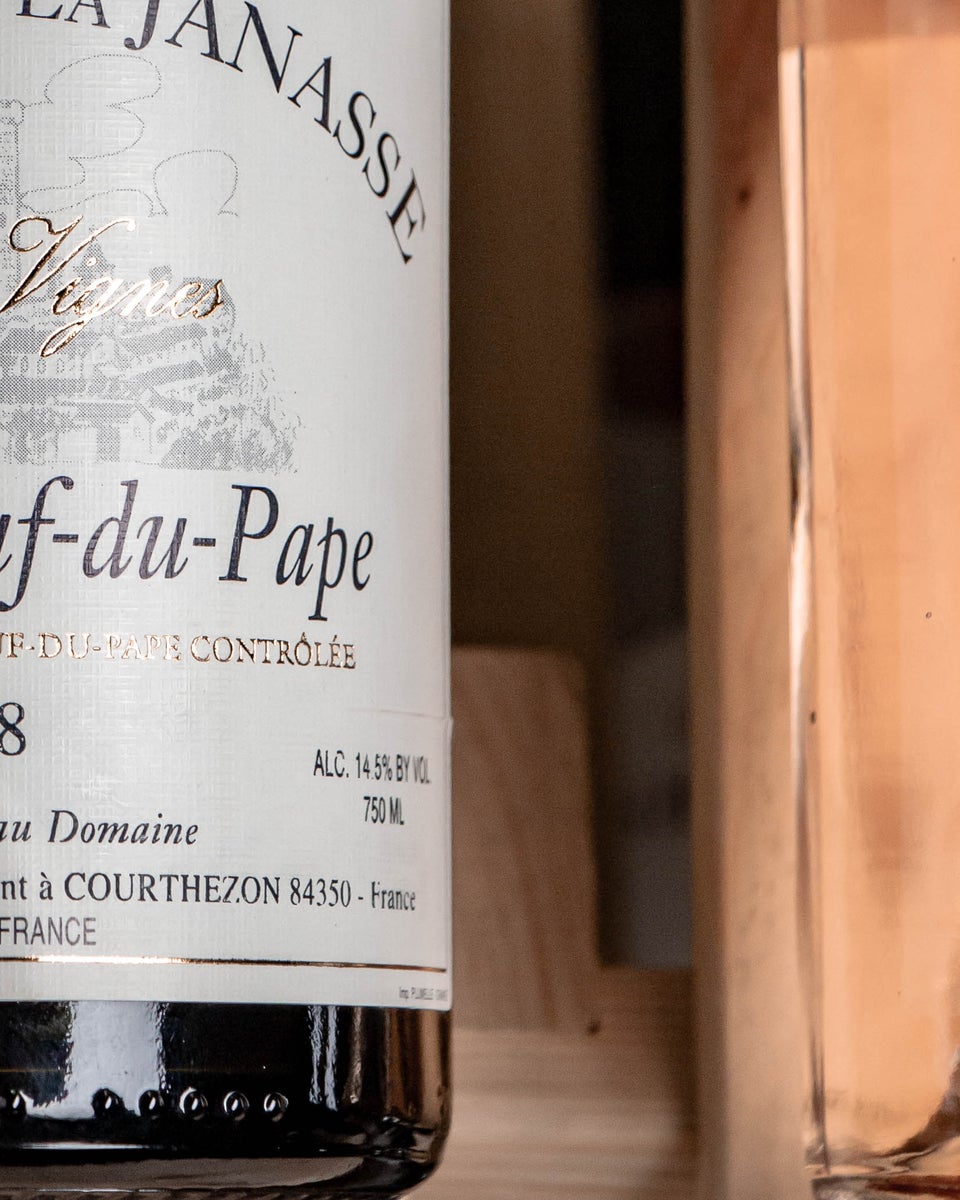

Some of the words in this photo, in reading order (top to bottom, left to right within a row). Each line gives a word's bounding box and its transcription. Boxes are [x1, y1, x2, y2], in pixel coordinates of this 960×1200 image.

[190, 632, 357, 669] CONTRÔLÉE
[313, 749, 349, 778] ALC.
[356, 752, 393, 781] 14.5%
[396, 754, 410, 782] BY
[47, 810, 199, 845] Domaine
[364, 796, 386, 824] 750
[390, 796, 405, 825] ML
[39, 872, 54, 901] à
[64, 872, 280, 905] COURTHEZON
[290, 877, 351, 907] 84350
[371, 881, 416, 911] France
